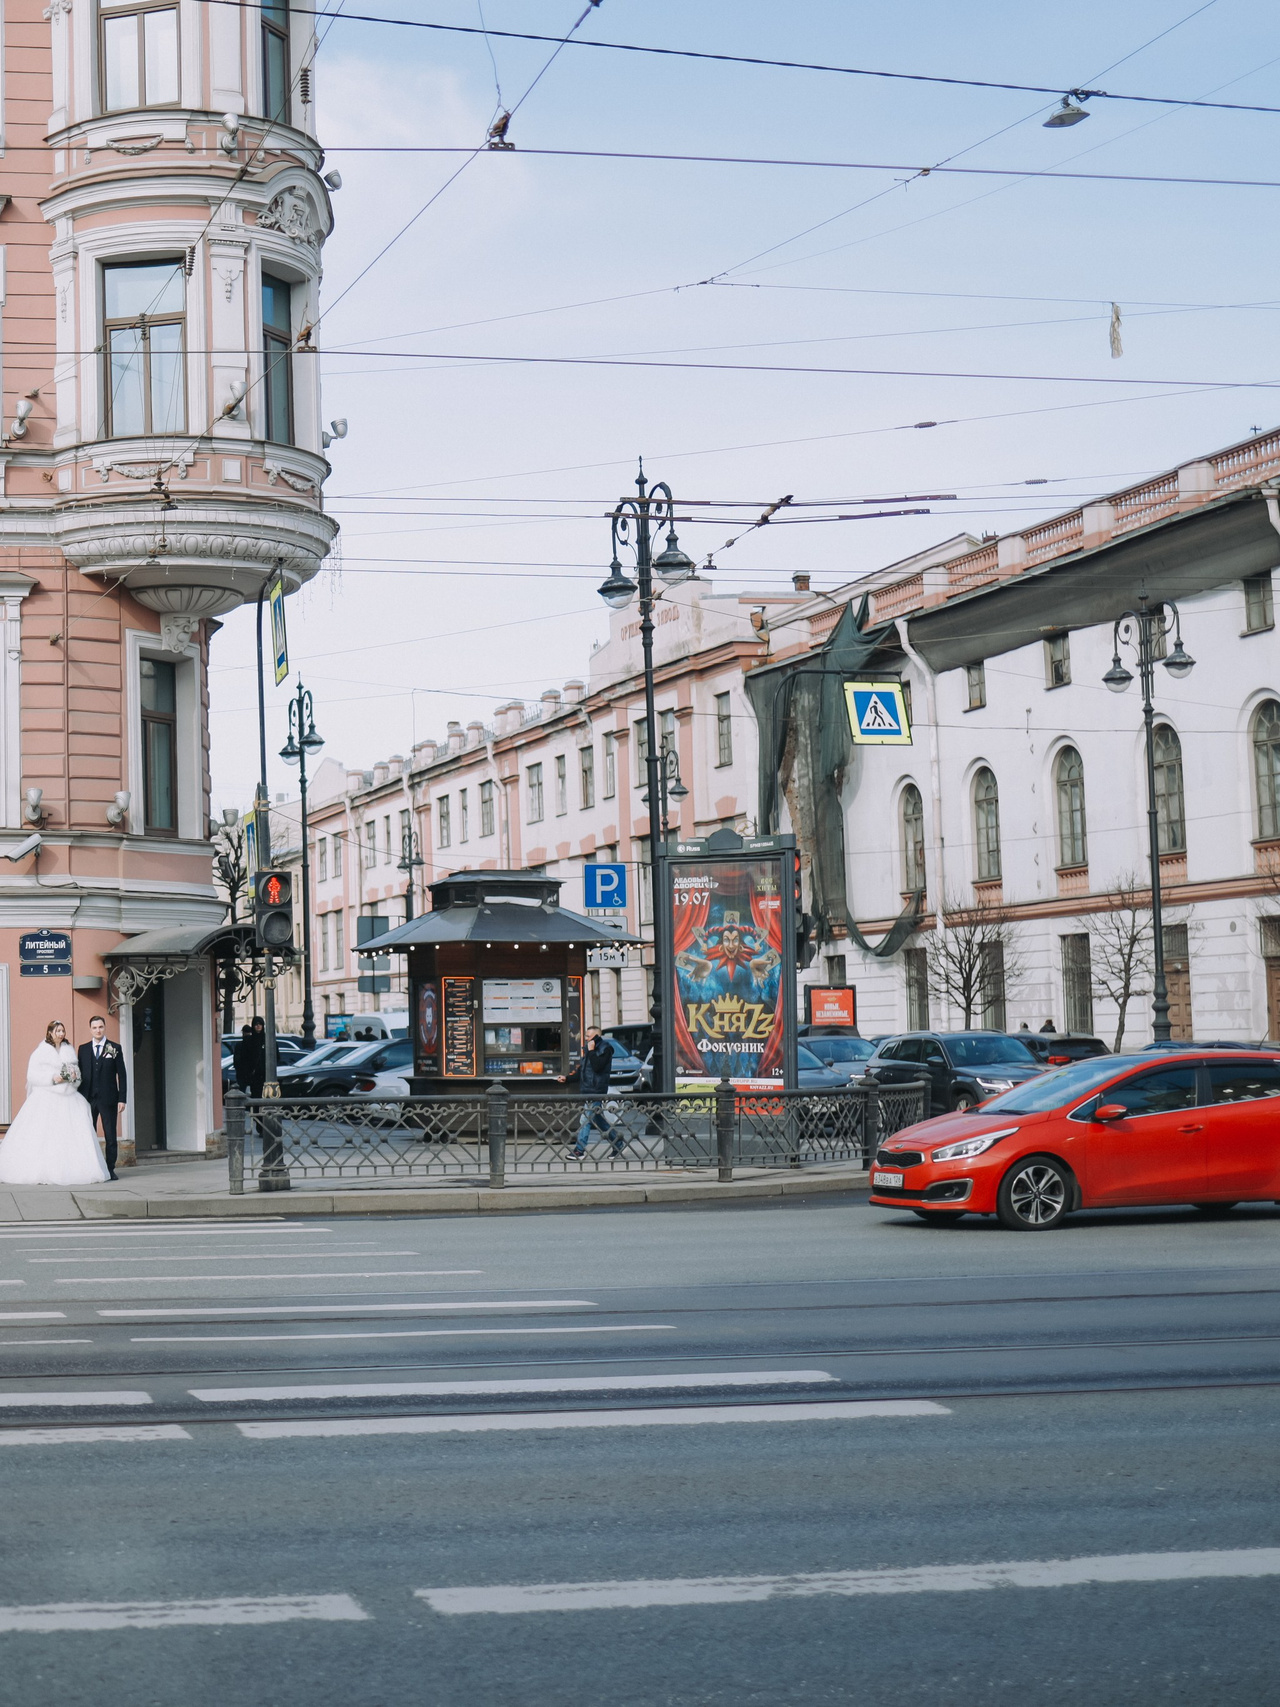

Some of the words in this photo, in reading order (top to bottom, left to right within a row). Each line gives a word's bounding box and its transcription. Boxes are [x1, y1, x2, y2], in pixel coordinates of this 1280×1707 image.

[596, 868, 619, 904] P
[674, 892, 710, 905] 19.07
[25, 940, 66, 949] ЛИТЕЙНЫЙ
[43, 964, 49, 974] 5
